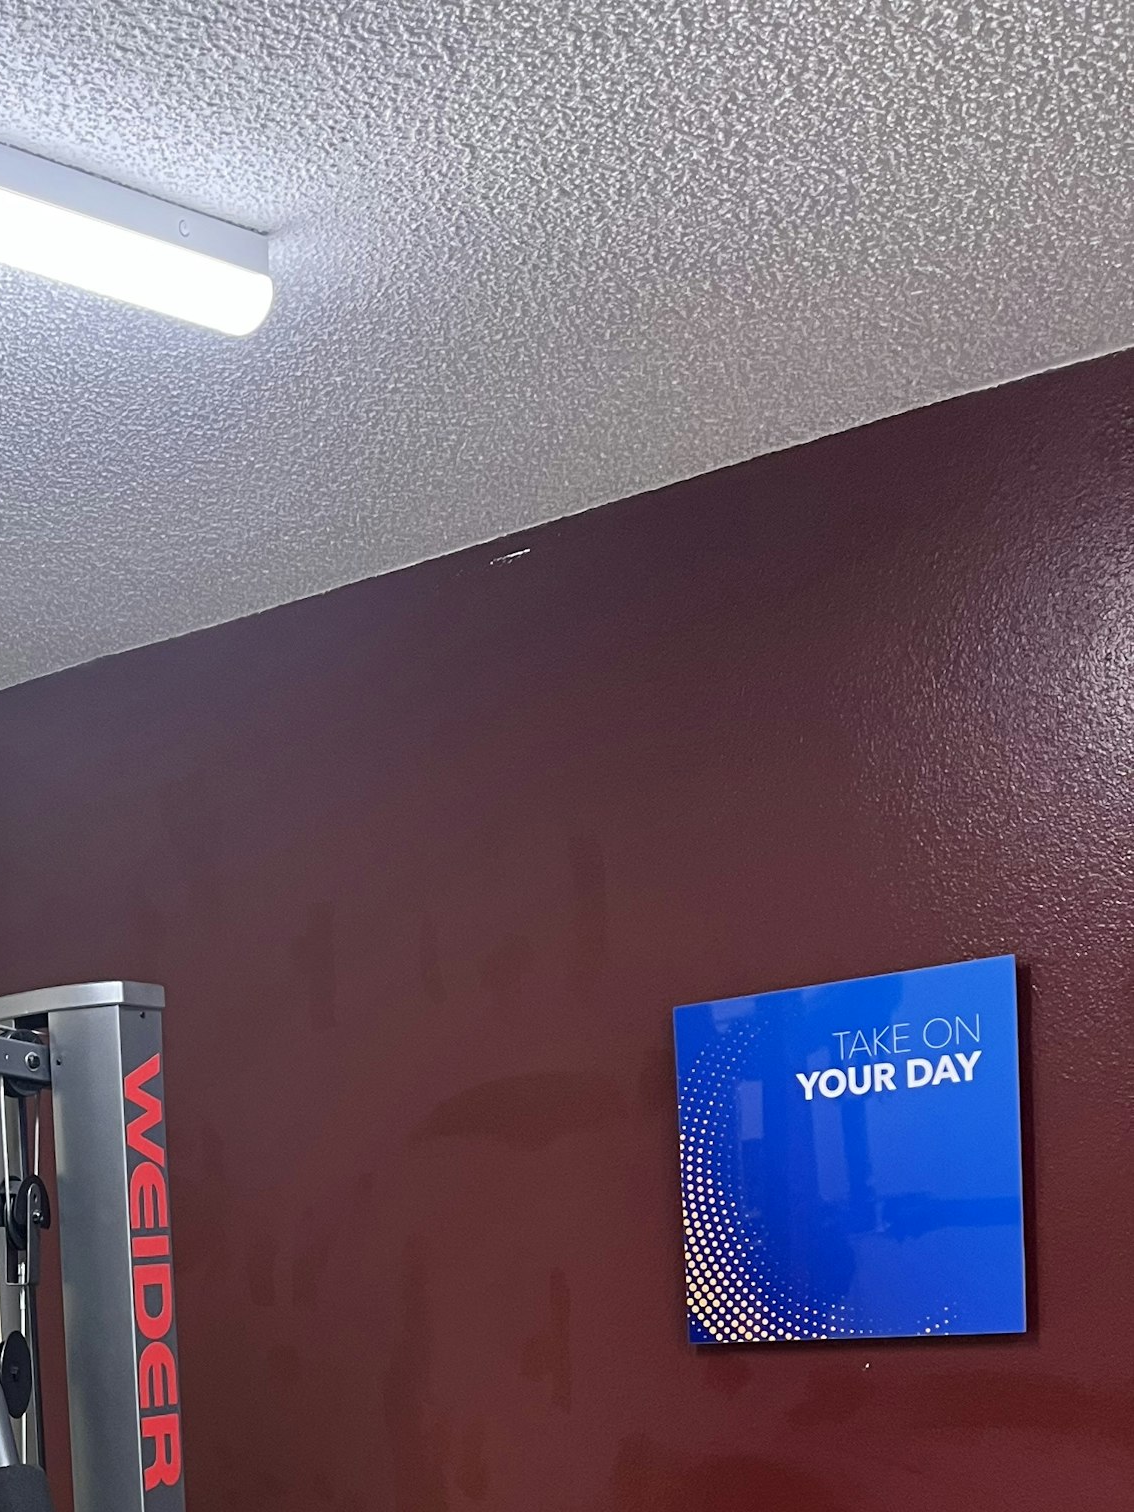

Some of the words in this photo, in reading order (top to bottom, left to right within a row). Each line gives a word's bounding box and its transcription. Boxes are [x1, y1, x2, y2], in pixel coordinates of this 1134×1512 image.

[832, 1022, 911, 1061] TAKE
[922, 1013, 981, 1048] ON
[796, 1063, 896, 1101] YOUR
[907, 1050, 983, 1089] DAY
[124, 1052, 182, 1492] WEIDER
